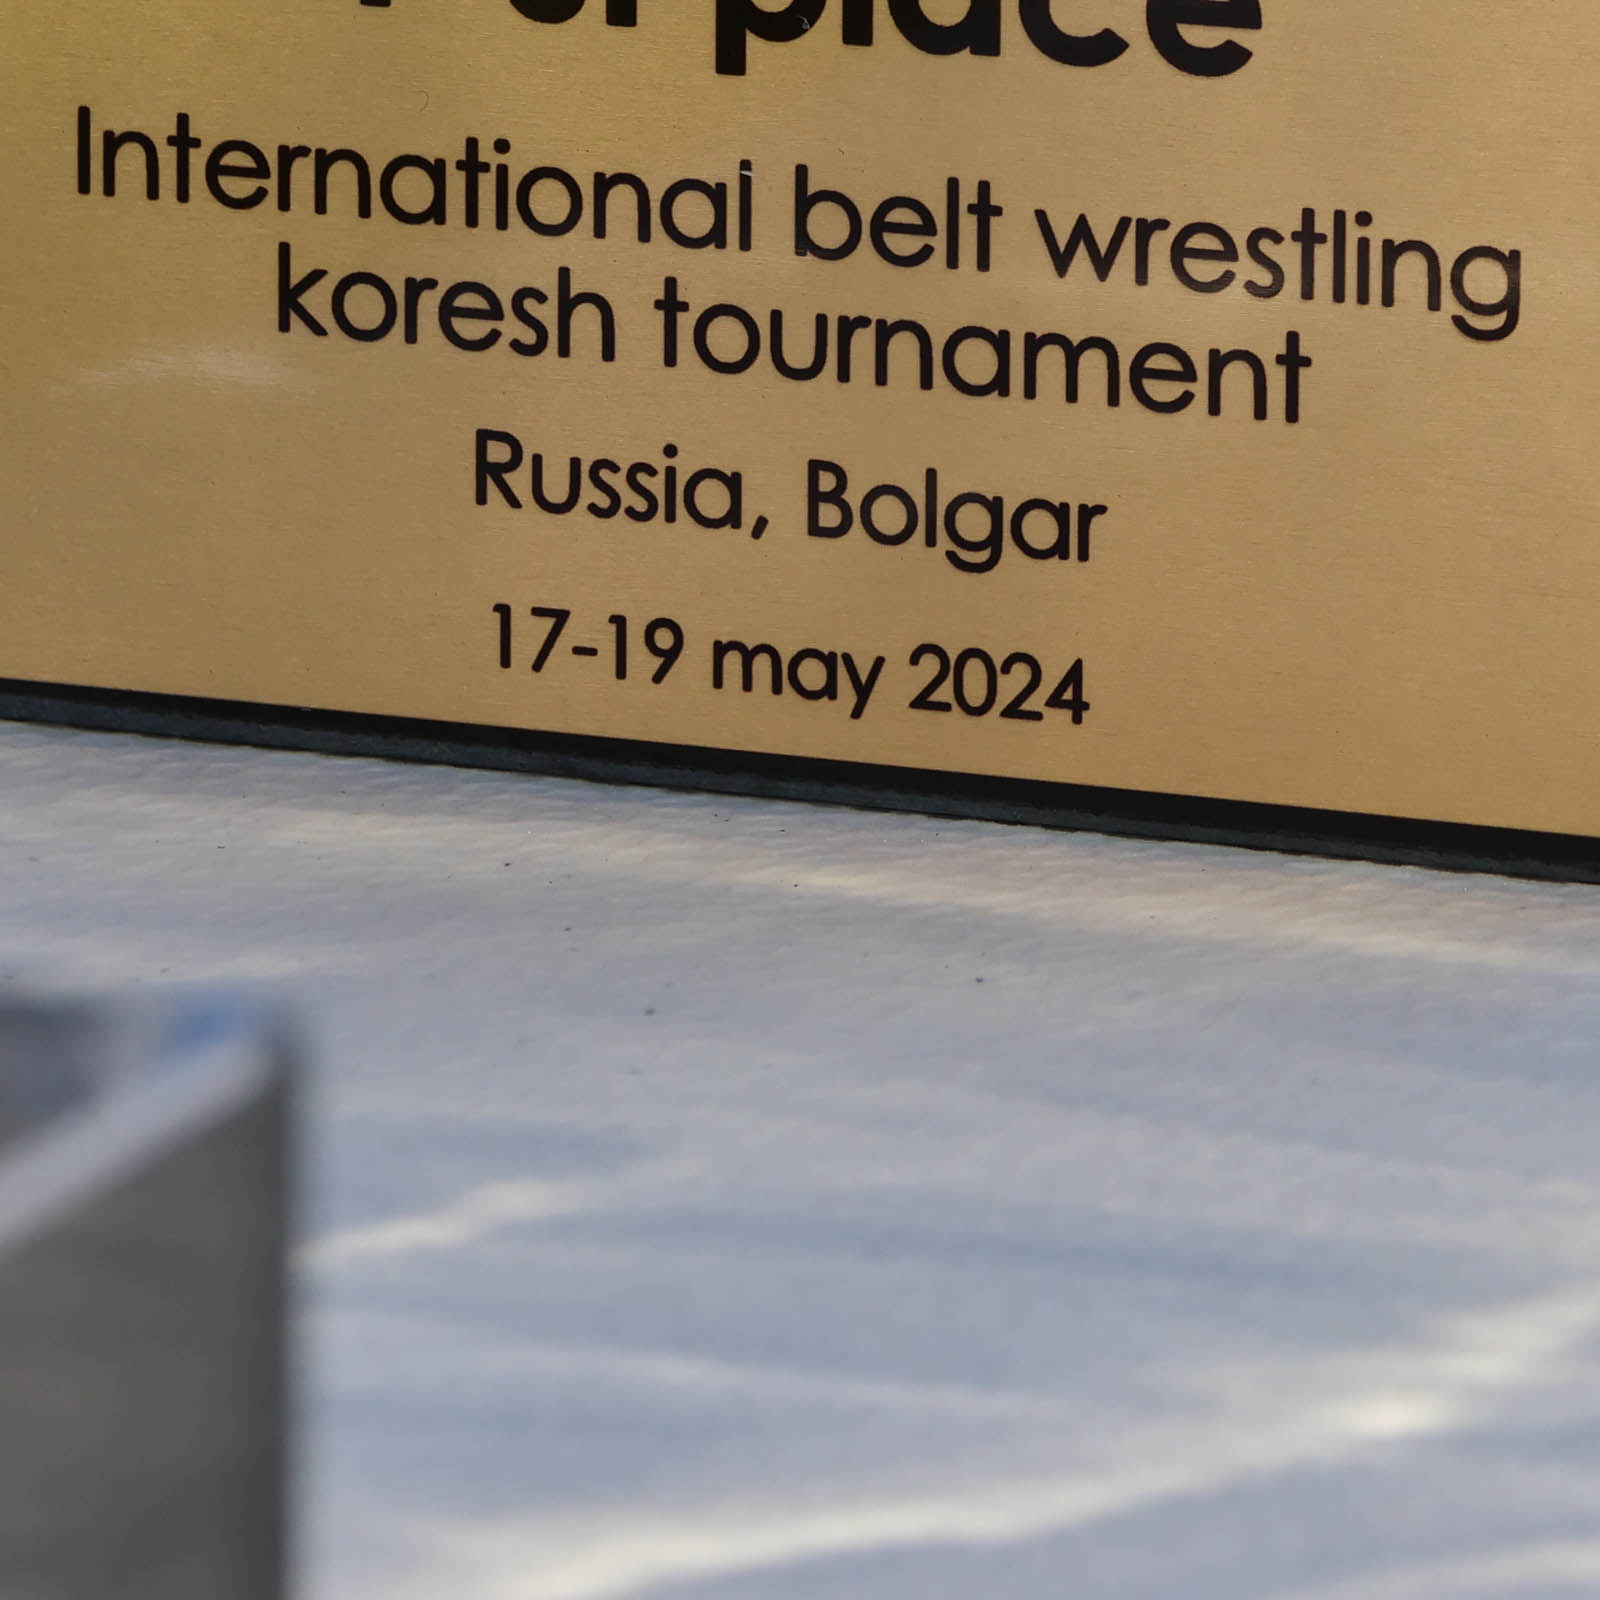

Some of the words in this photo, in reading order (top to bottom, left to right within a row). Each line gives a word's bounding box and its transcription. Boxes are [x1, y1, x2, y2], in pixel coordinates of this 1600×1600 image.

[75, 102, 754, 254] International
[792, 161, 1005, 274] belt
[1032, 206, 1523, 344] wrestling
[276, 239, 617, 364] koresh
[652, 274, 1314, 426] tournament
[473, 426, 771, 542] Russia,
[805, 457, 1110, 576] Bolgar
[490, 601, 686, 687] 17-19
[710, 638, 888, 722] may
[906, 641, 1092, 727] 2024
